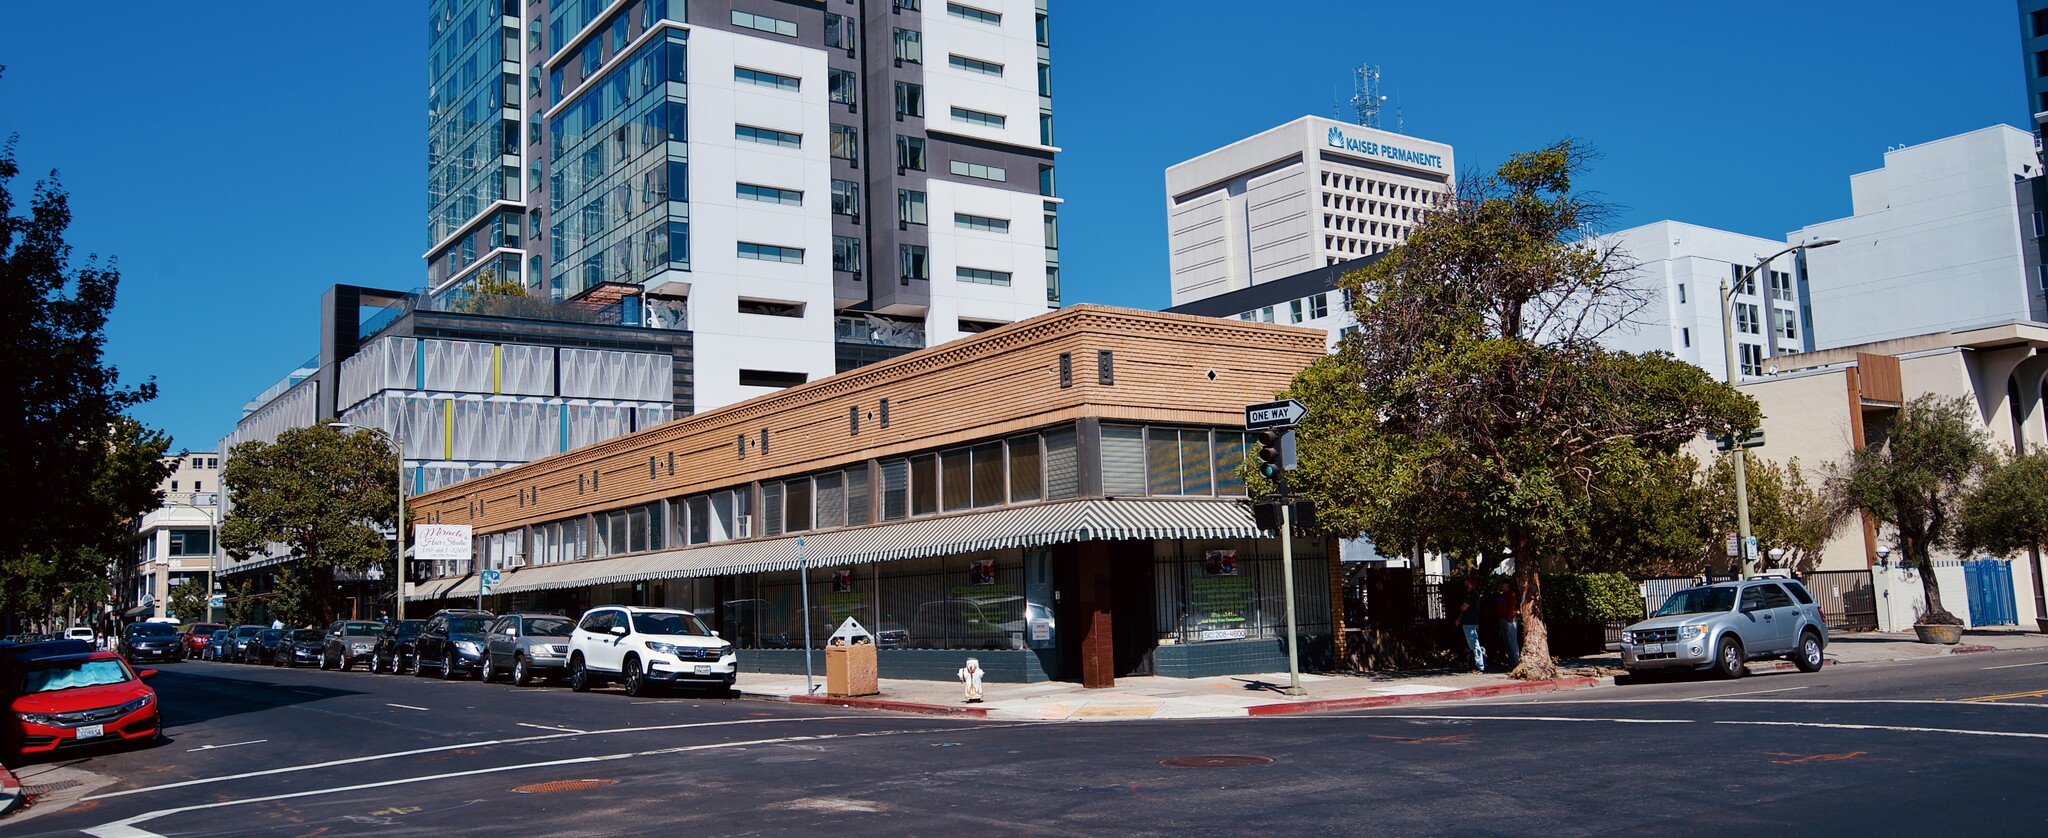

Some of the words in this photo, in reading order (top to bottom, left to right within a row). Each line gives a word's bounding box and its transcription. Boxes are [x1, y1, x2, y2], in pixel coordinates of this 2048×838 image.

[1346, 137, 1379, 156] KAISER
[1381, 145, 1442, 168] PERMANENTE
[1252, 411, 1269, 421] ONE
[1271, 408, 1289, 419] WAY
[420, 538, 443, 547] Hair
[443, 537, 467, 546] Studio
